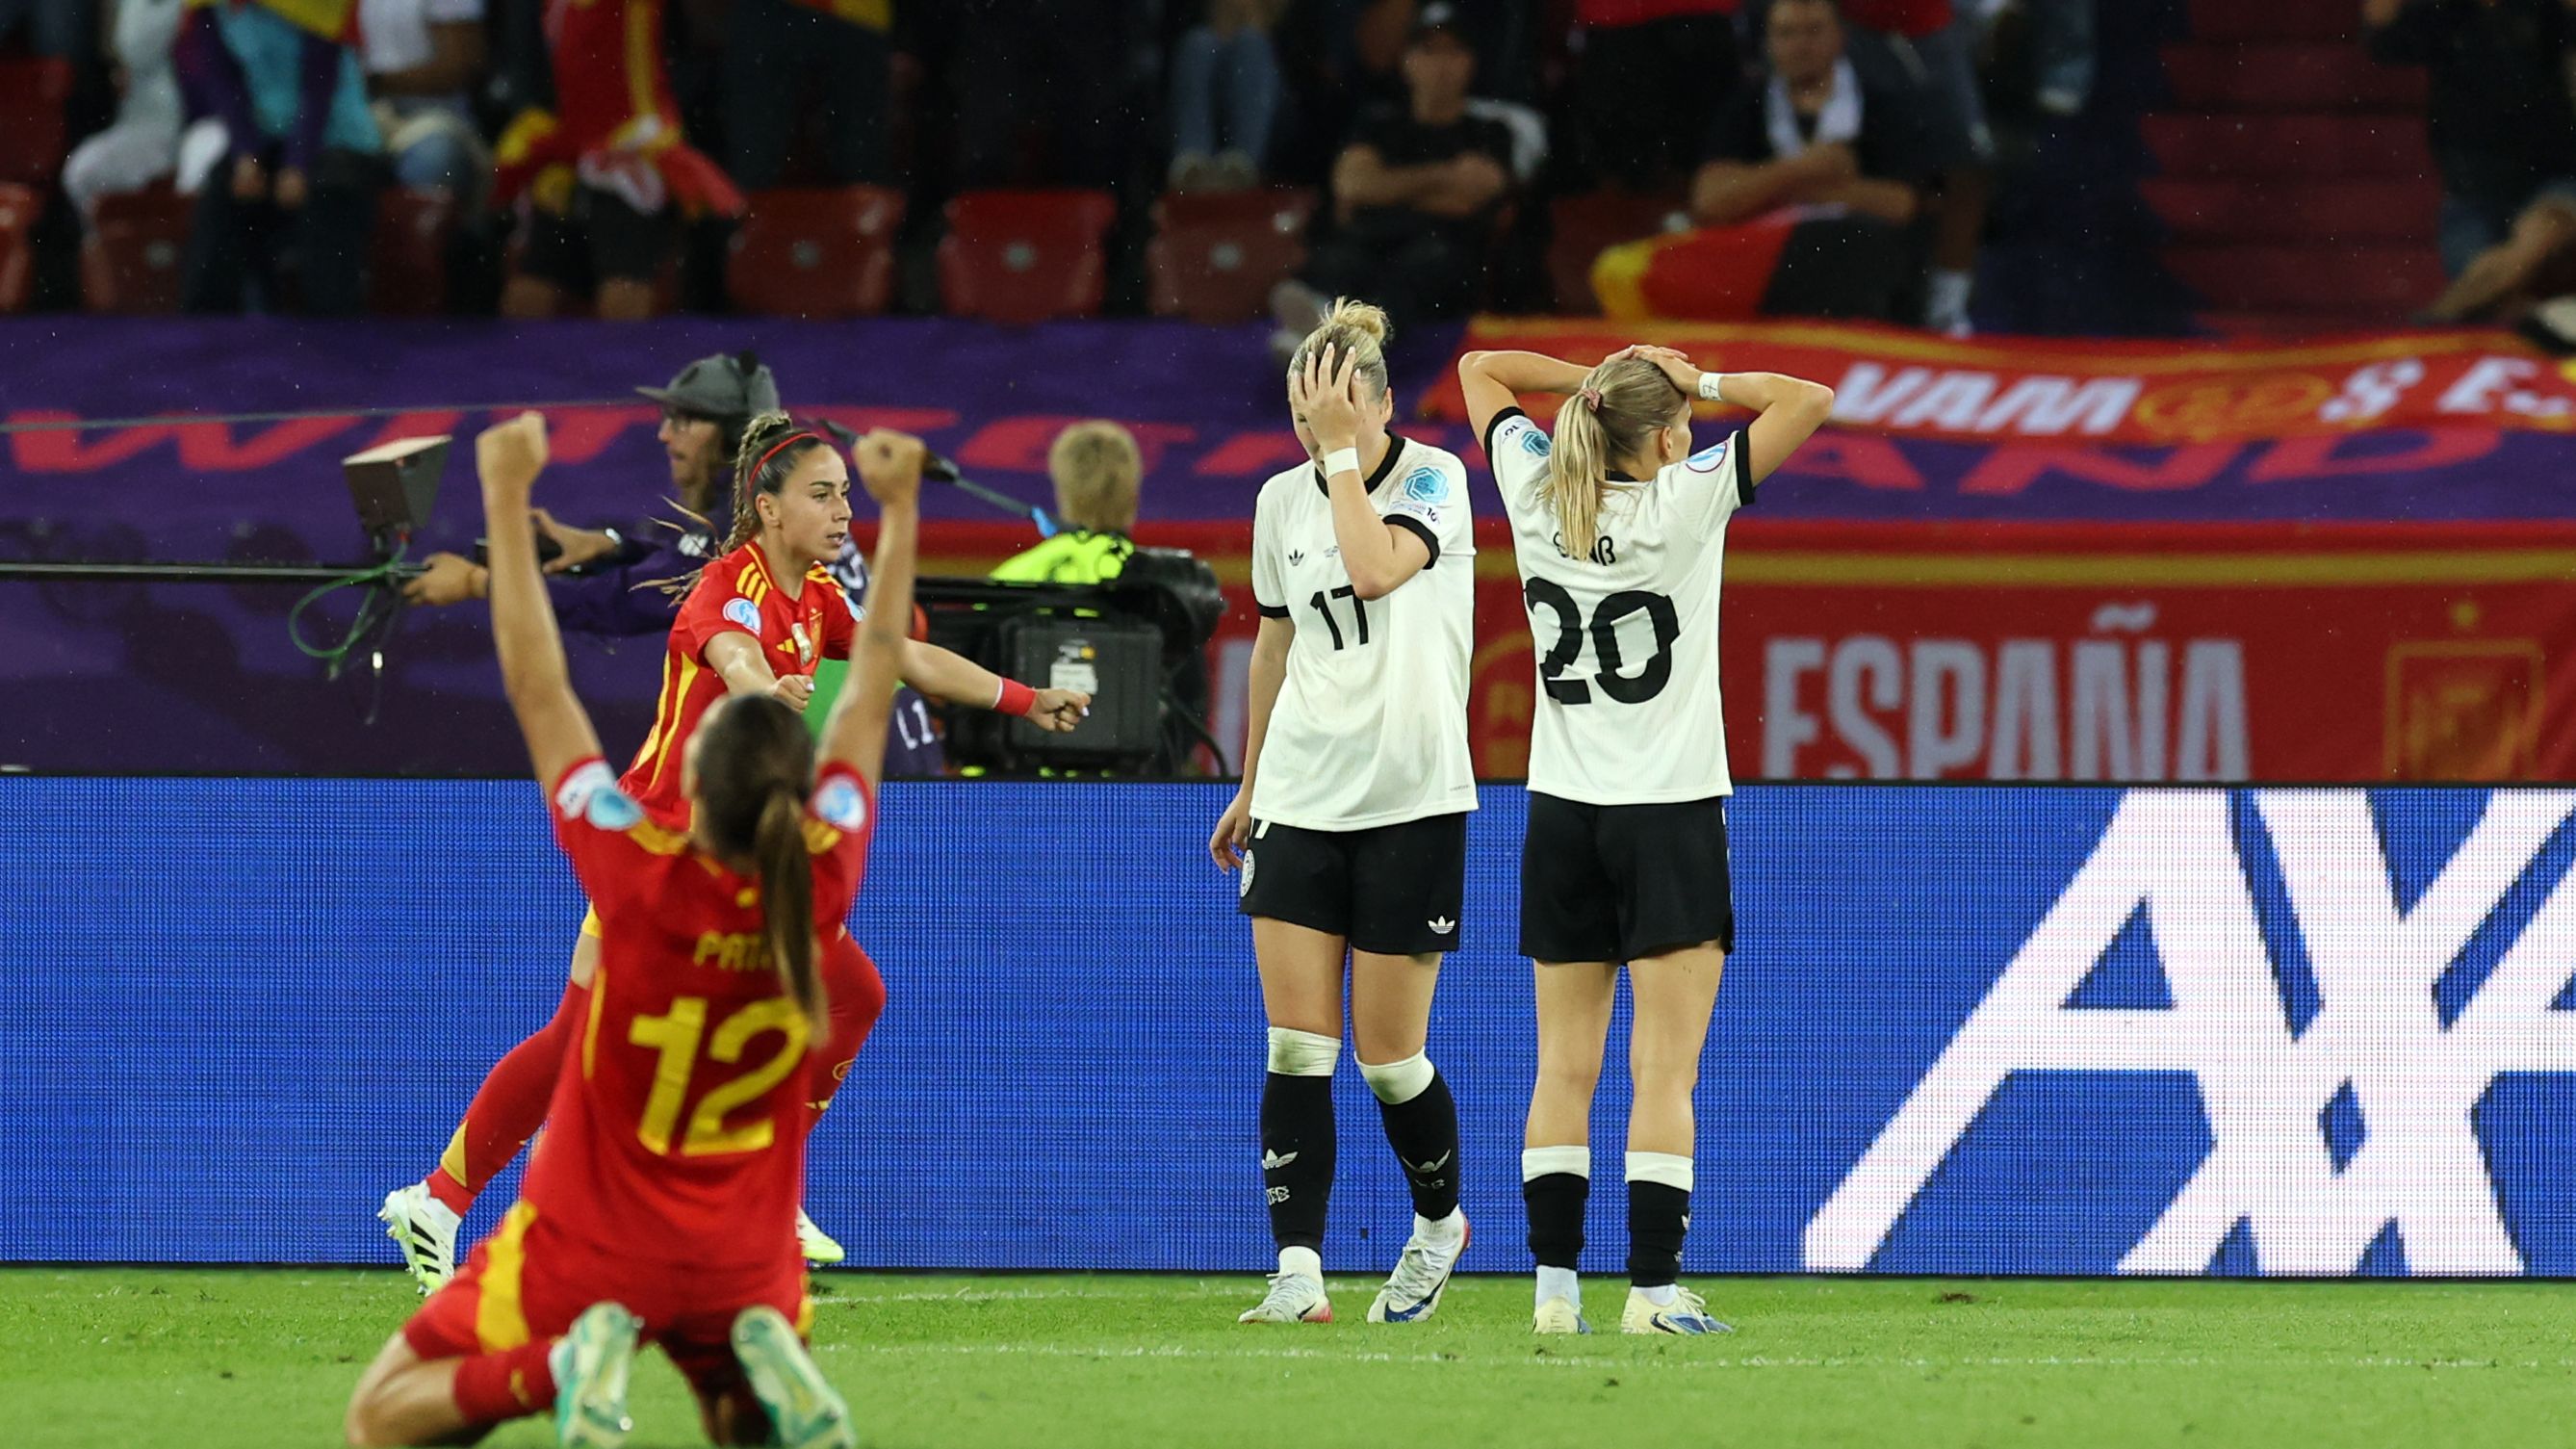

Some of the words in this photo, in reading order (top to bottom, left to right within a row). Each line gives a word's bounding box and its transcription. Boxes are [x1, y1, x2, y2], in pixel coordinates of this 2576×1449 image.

[1309, 583, 1369, 652] 17
[1525, 576, 1681, 706] 20
[1761, 601, 2251, 782] ESPAÑA
[627, 996, 812, 1156] 12
